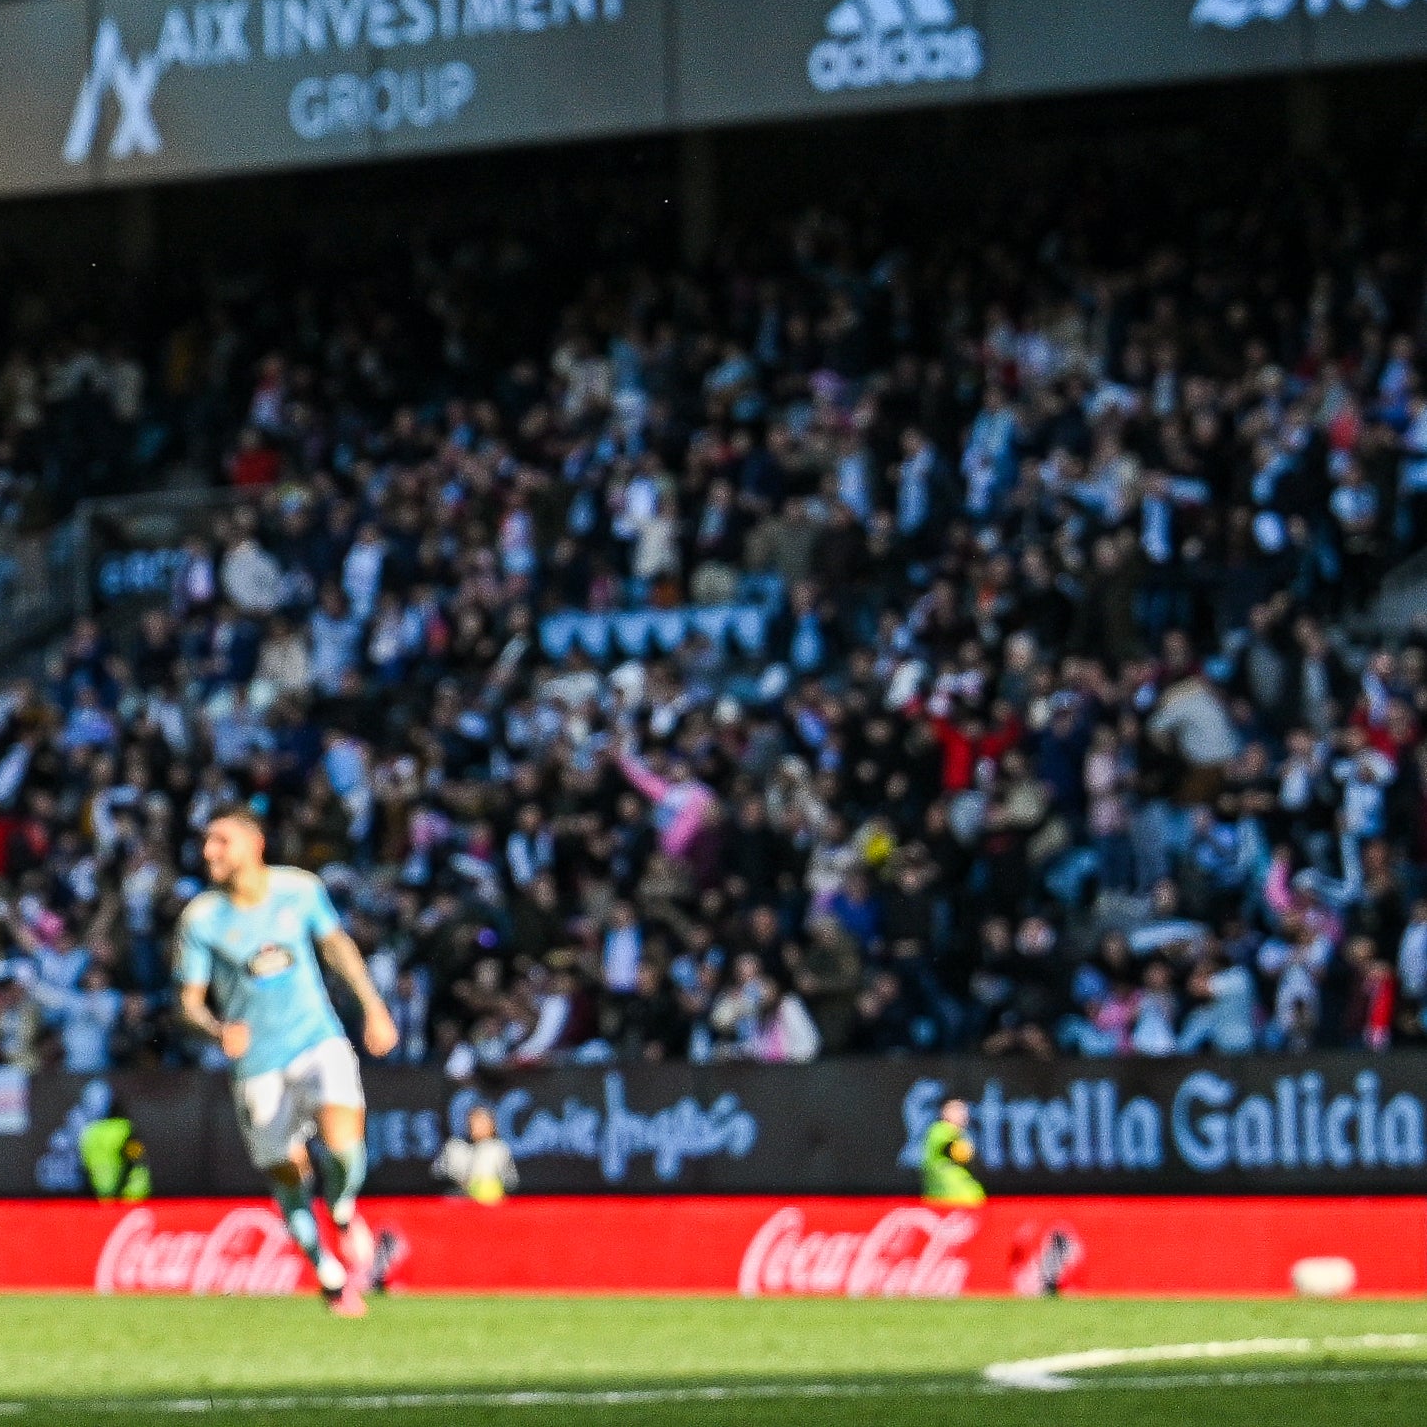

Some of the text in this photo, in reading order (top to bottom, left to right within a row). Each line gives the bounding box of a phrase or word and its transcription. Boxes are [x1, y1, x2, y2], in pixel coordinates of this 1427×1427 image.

[807, 25, 984, 93] adidas
[288, 60, 477, 140] GROUP
[1171, 1071, 1424, 1172] Galicia
